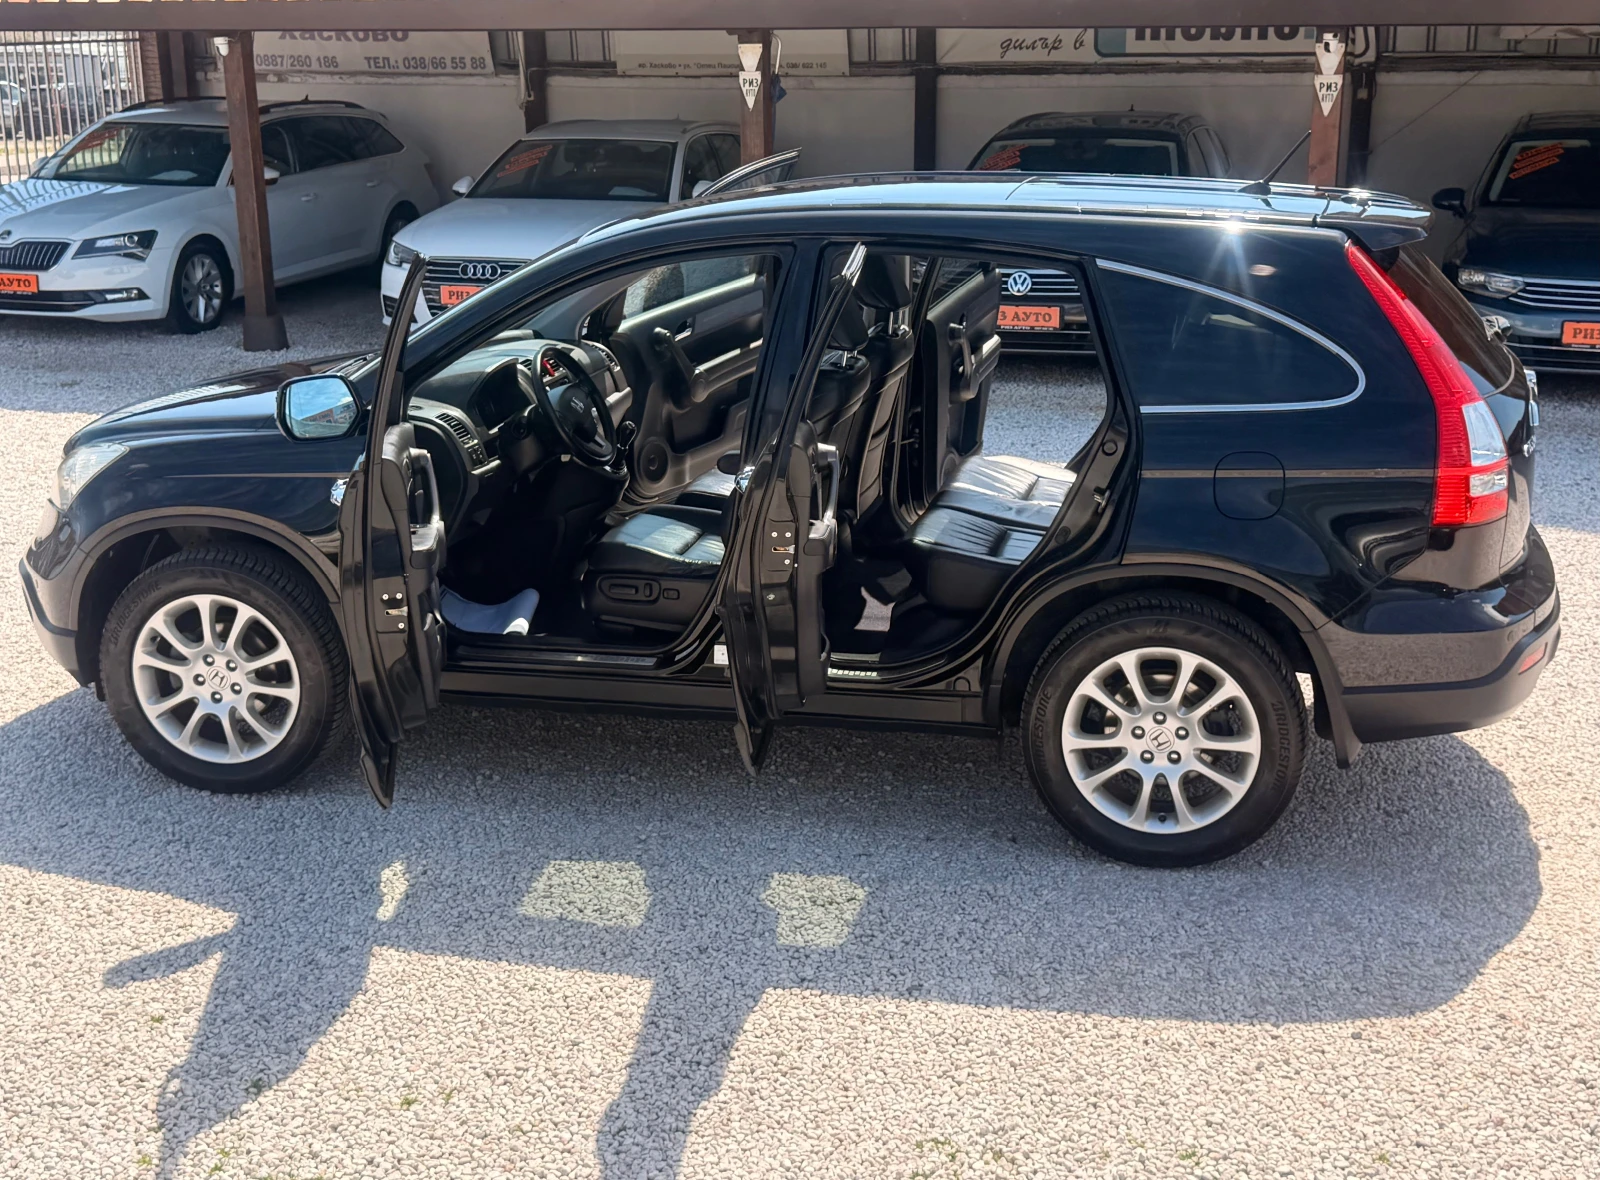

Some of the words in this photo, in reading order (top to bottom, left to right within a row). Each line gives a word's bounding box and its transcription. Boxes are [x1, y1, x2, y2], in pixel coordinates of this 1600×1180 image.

[1000, 33, 1063, 59] дилър
[255, 54, 312, 69] 0887/260
[316, 56, 338, 69] 186
[364, 56, 399, 70] ТЕЛ.:
[402, 56, 447, 71] 038/66
[451, 56, 467, 70] 55
[470, 57, 487, 70] 88
[742, 78, 759, 88] РИЗ
[1318, 82, 1339, 93] РИЗ
[1011, 311, 1053, 323] АУТО
